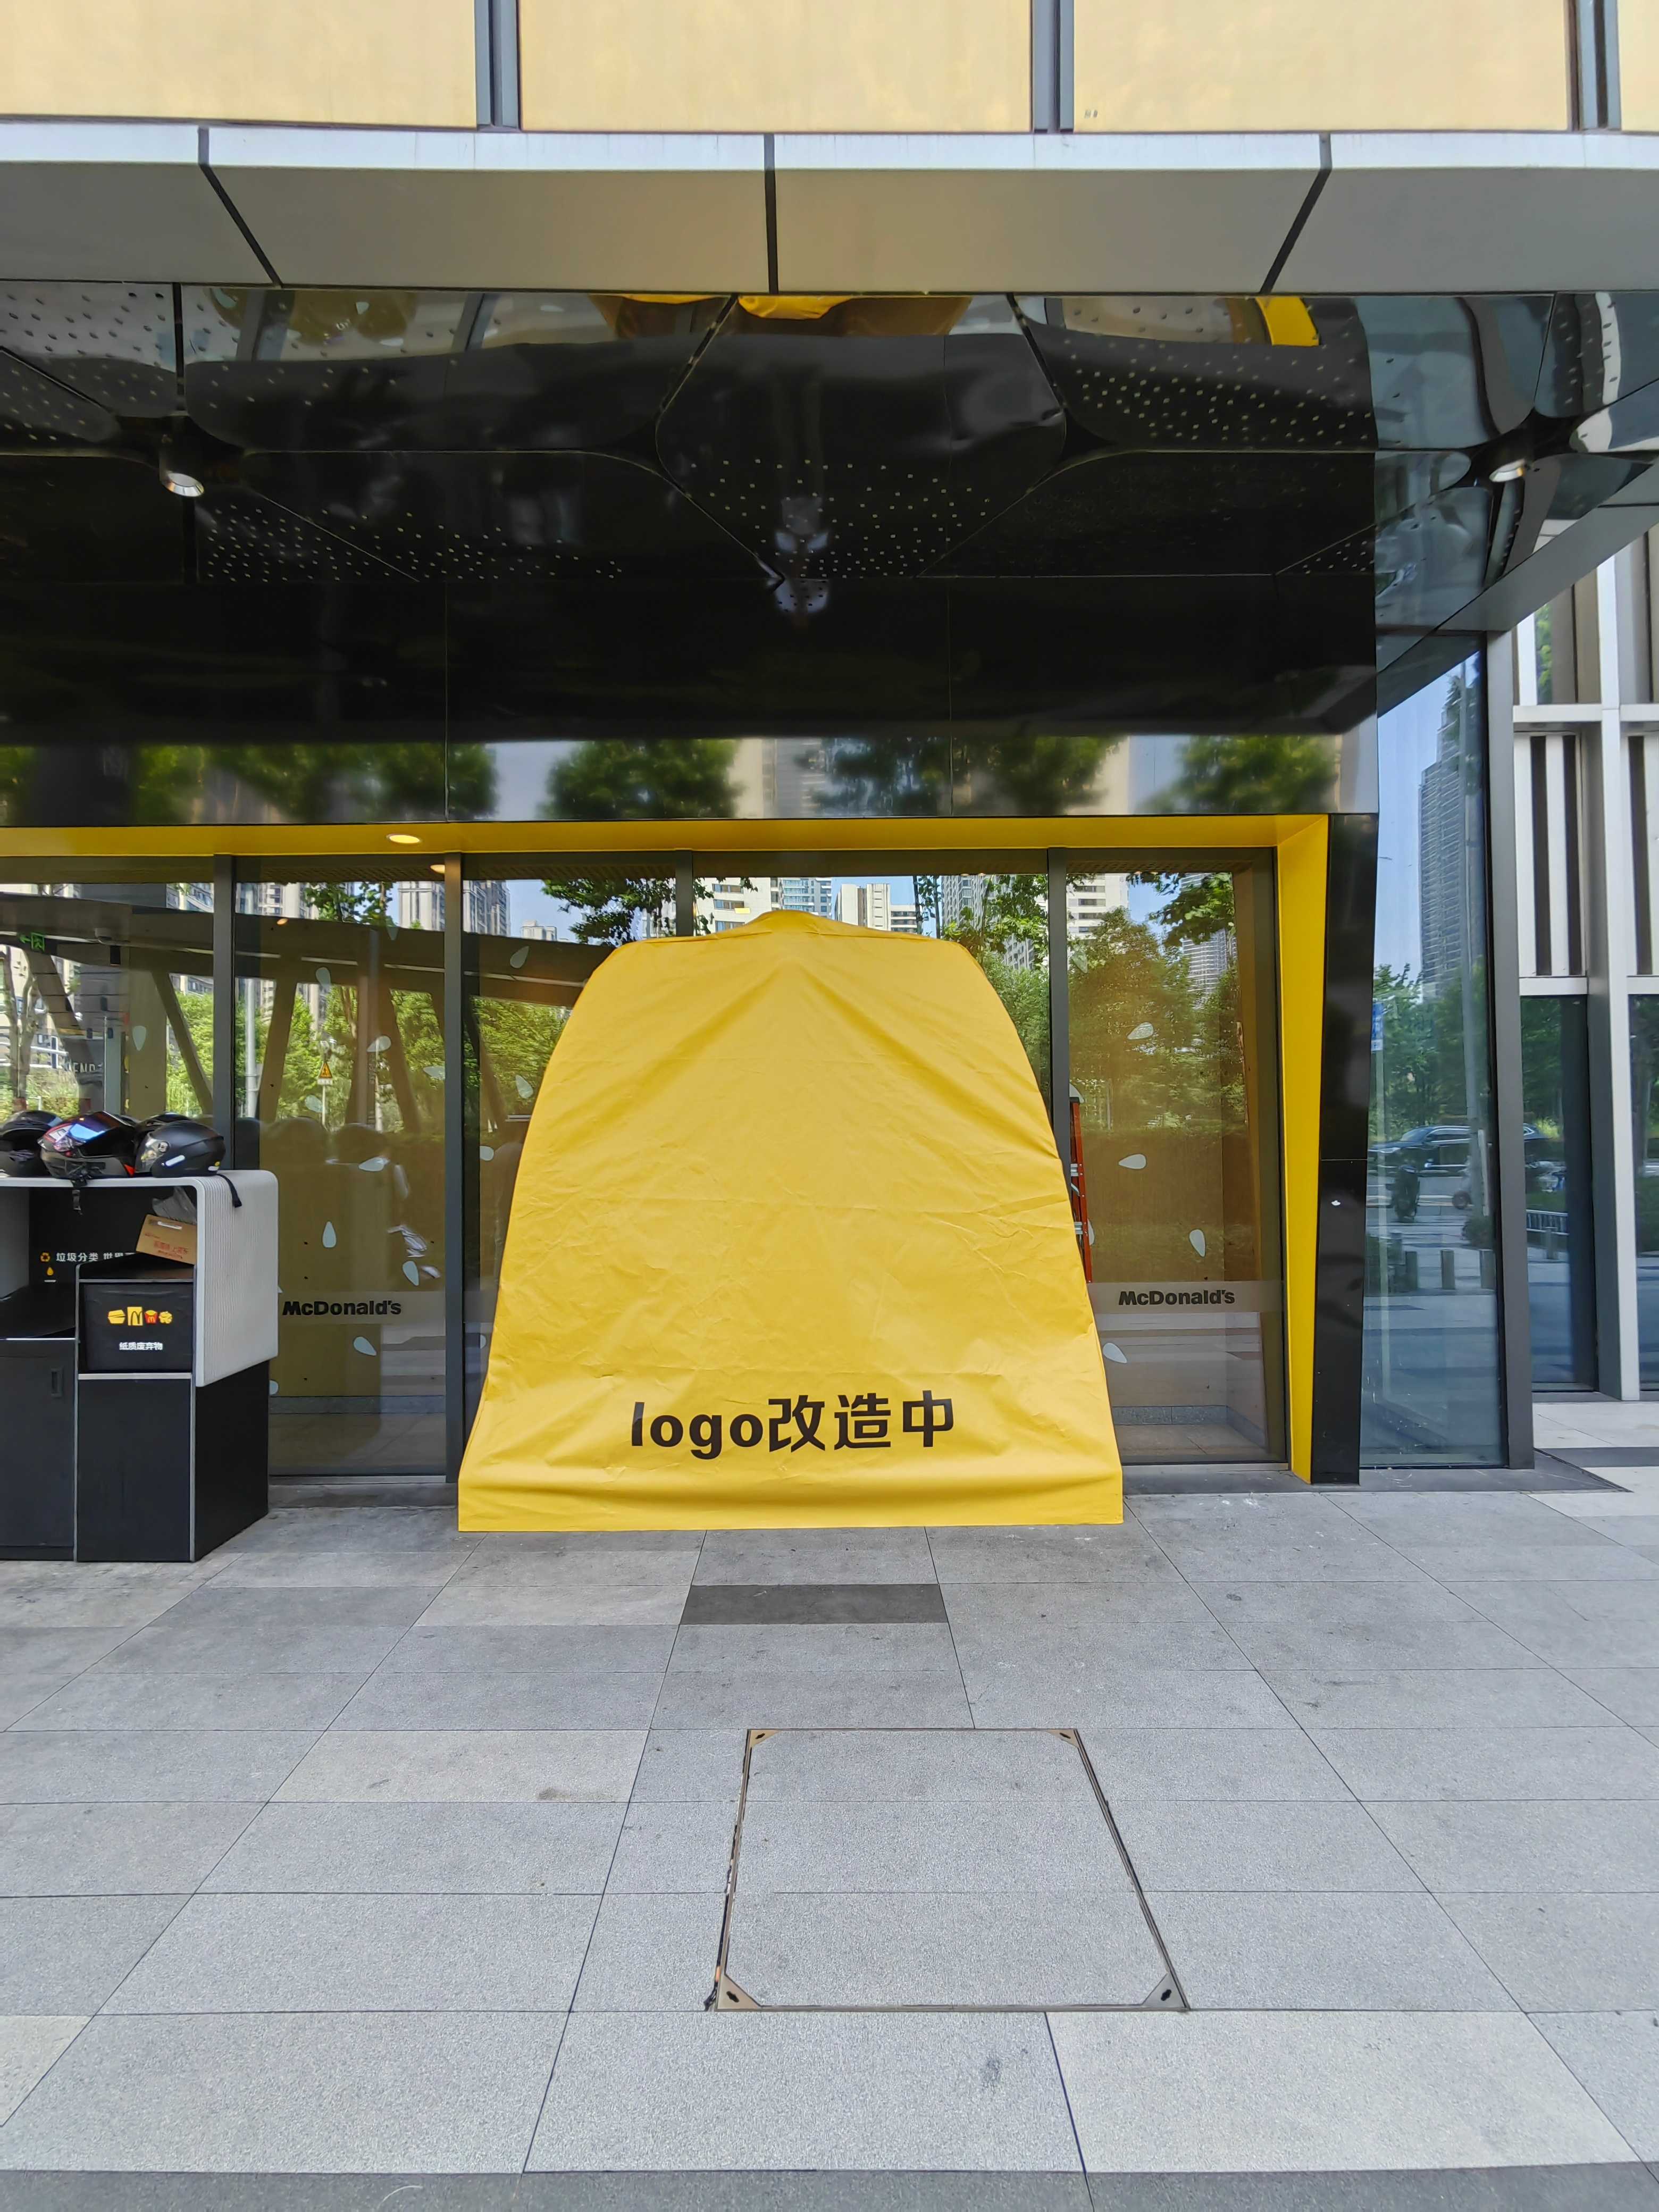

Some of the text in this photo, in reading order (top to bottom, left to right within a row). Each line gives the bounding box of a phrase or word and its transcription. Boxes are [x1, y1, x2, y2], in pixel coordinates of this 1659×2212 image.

[56, 1252, 99, 1262] 垃圾分类
[1118, 1289, 1235, 1305] McDonald's
[282, 1300, 401, 1316] McDonald's
[119, 1342, 163, 1351] 纸质废弃物
[631, 1390, 954, 1460] logo改造中
